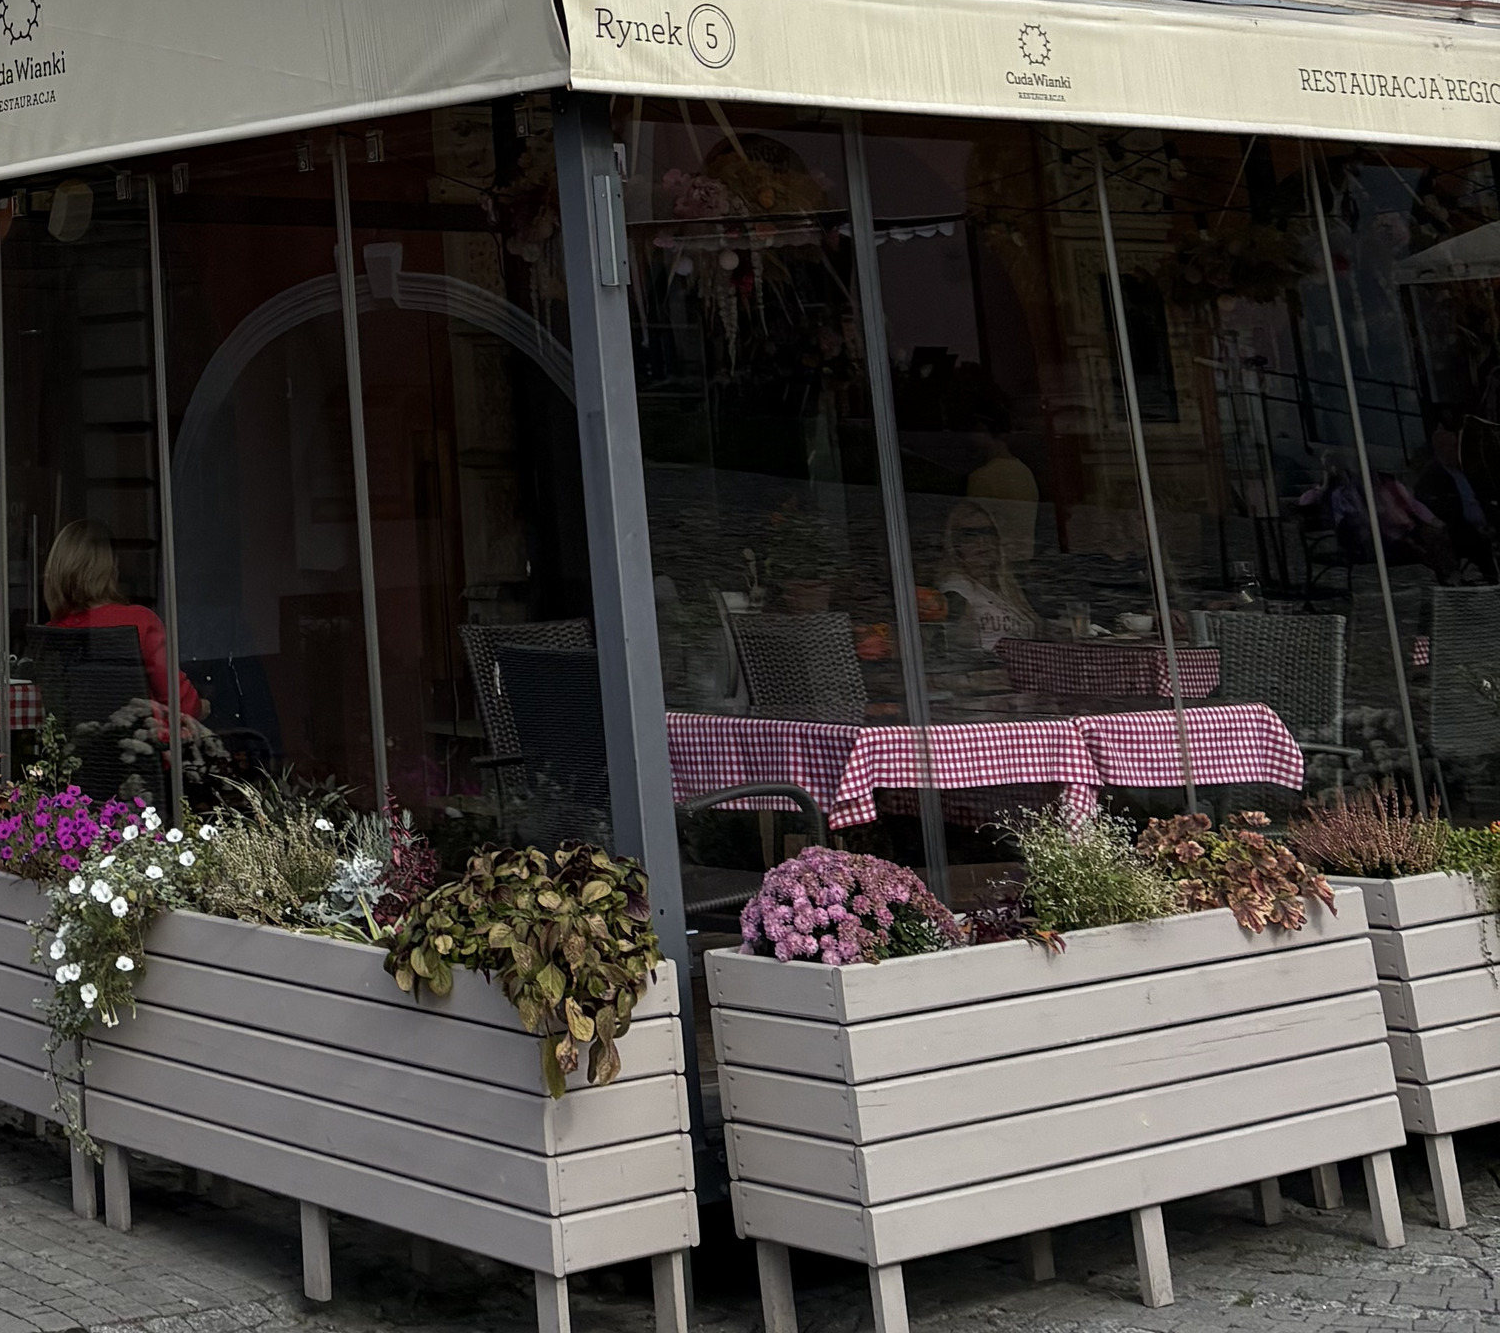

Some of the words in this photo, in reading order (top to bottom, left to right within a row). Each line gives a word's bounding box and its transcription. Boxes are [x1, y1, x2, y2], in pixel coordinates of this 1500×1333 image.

[594, 7, 683, 49] Rynek
[705, 22, 719, 50] 5
[1298, 68, 1444, 100] RESTAURACJA
